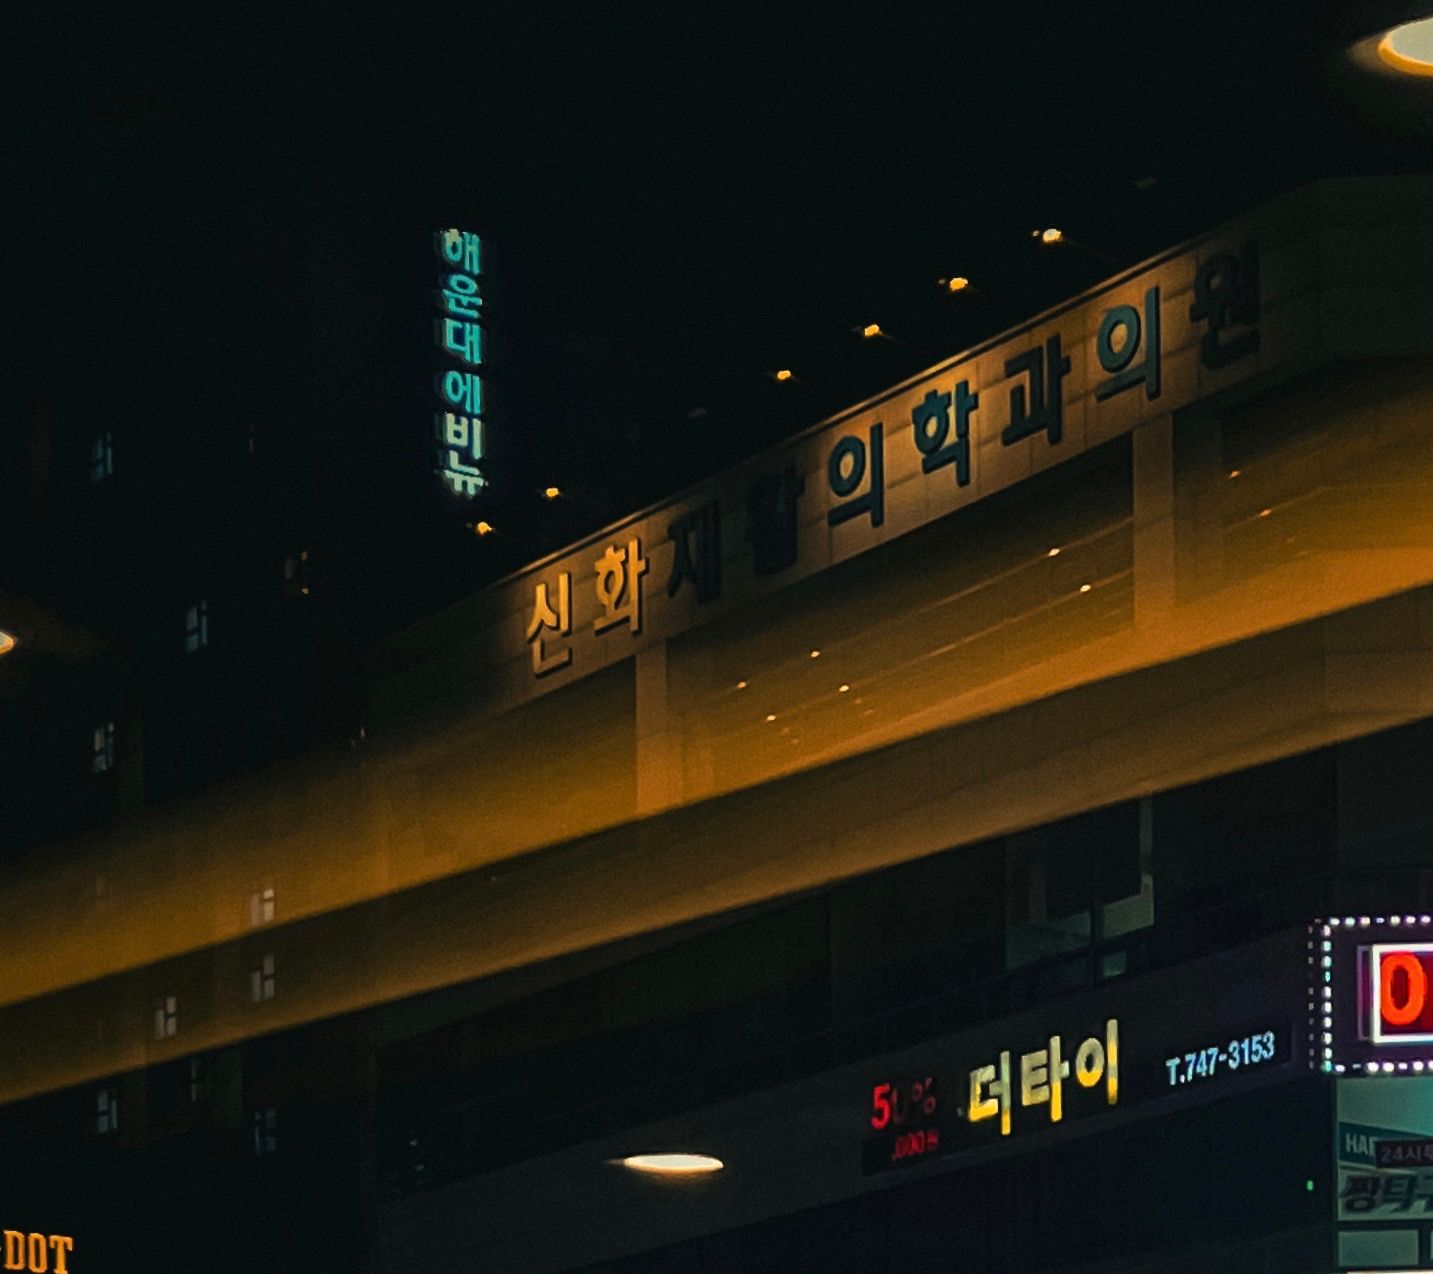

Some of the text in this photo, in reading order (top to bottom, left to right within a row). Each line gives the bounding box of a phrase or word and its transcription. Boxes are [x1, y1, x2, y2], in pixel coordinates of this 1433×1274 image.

[441, 228, 487, 497] 해운대 에비뉴
[966, 1018, 1120, 1136] 더타이
[1164, 1030, 1275, 1087] T.747-3153
